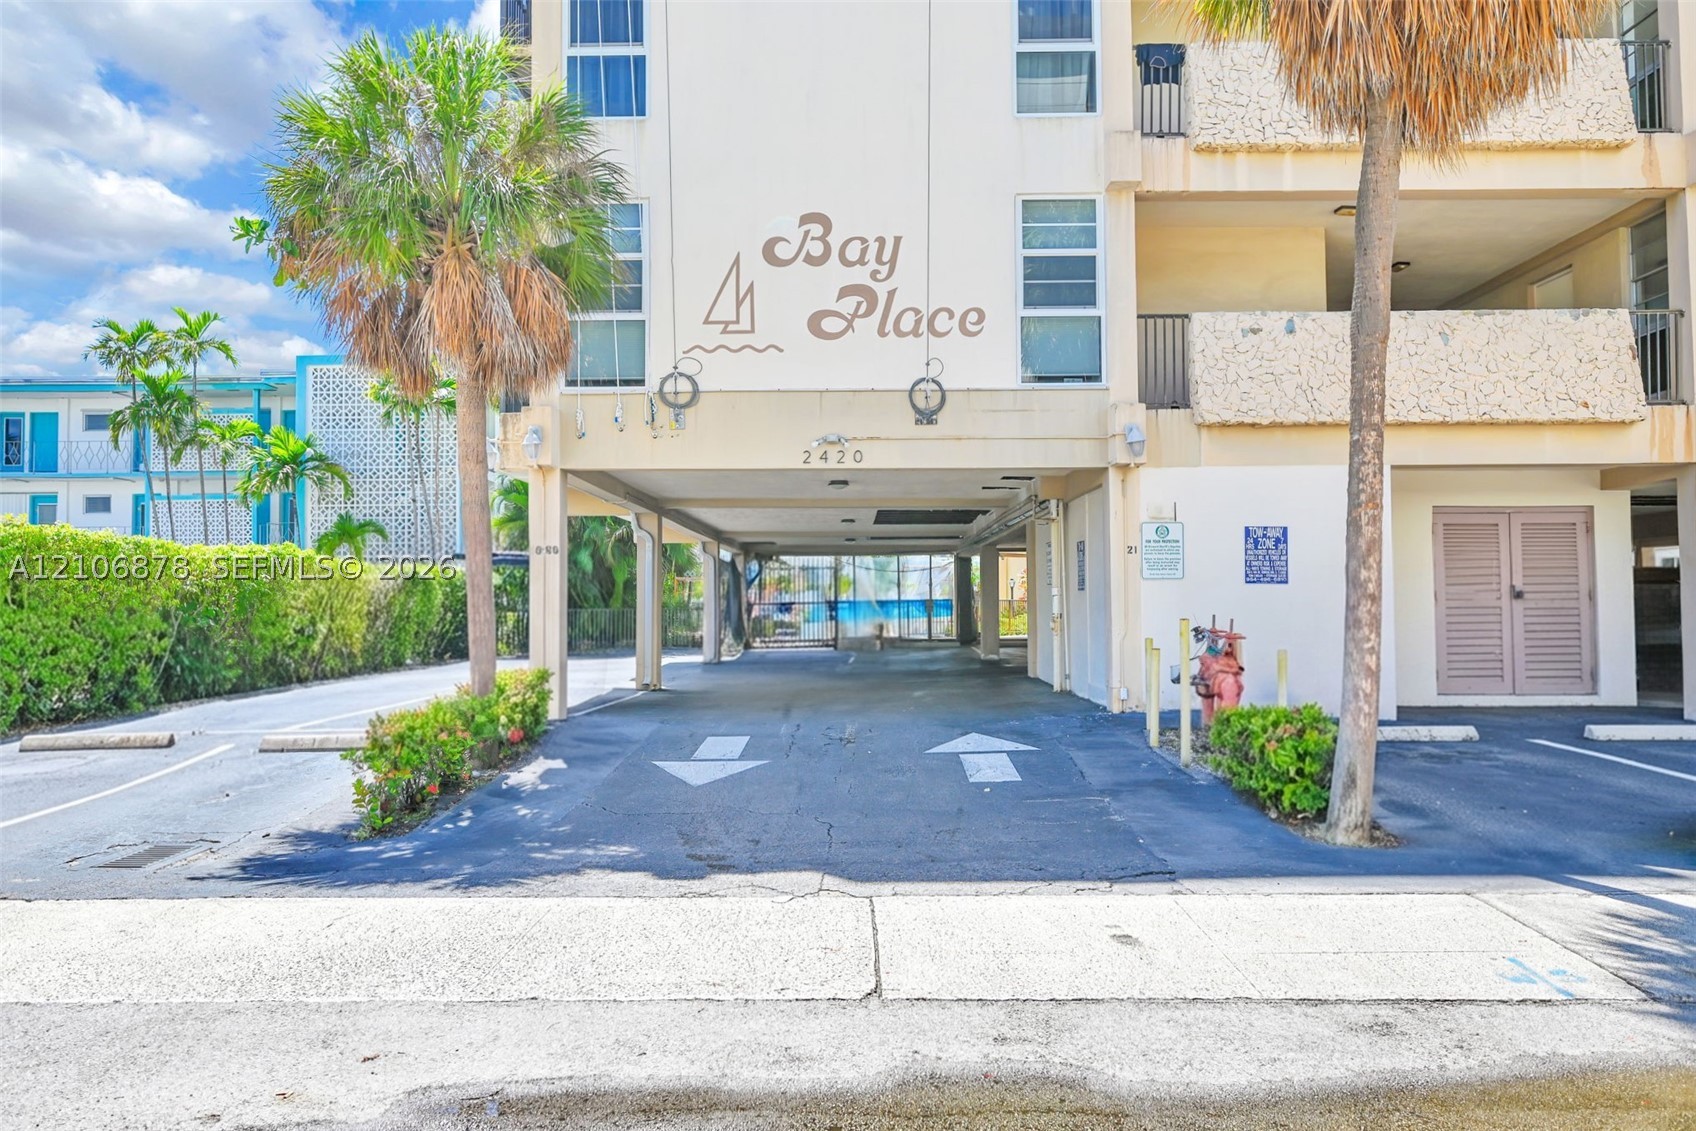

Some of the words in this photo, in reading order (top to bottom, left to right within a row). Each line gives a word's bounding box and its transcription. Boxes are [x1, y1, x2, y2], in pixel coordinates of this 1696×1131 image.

[762, 211, 903, 283] Bay
[807, 283, 986, 341] Place
[802, 450, 863, 464] 2420
[1249, 527, 1284, 538] TOW-AWAY
[1258, 538, 1275, 549] ZONE
[1127, 545, 1137, 555] 21
